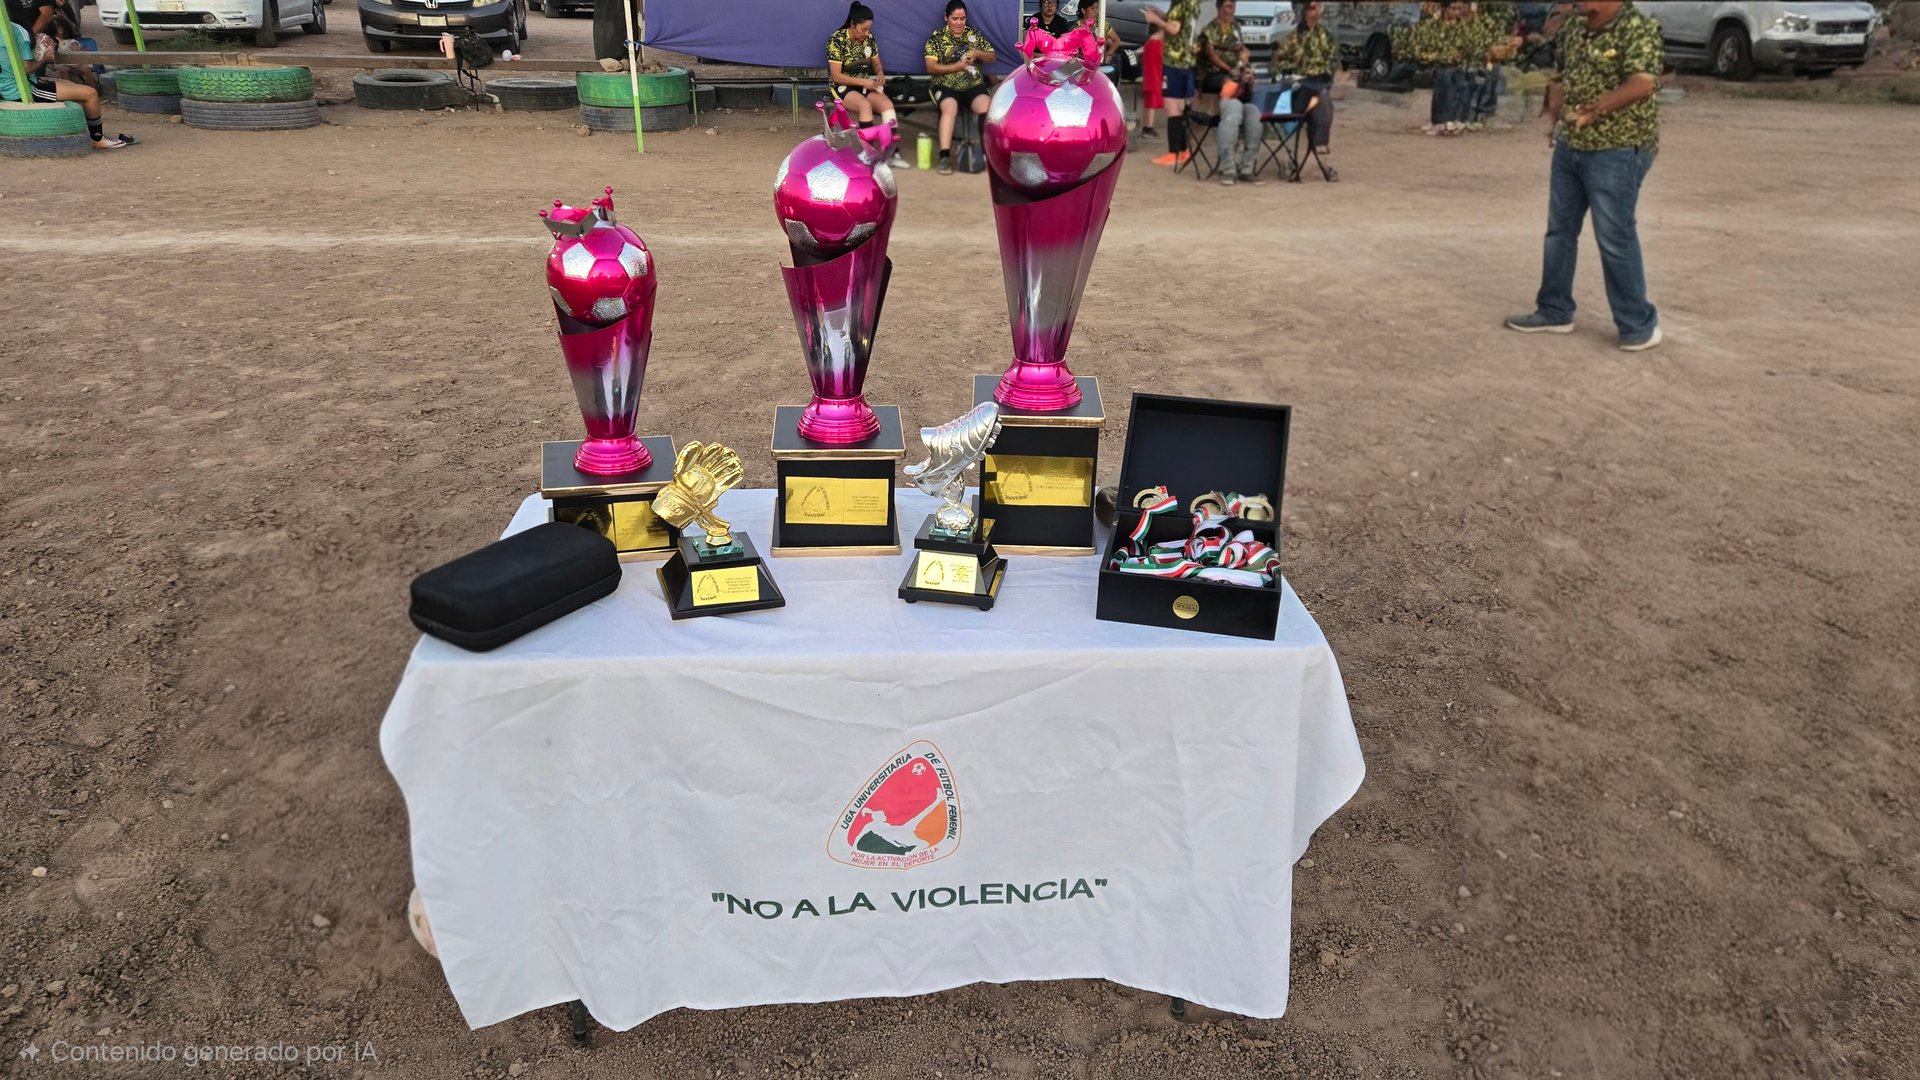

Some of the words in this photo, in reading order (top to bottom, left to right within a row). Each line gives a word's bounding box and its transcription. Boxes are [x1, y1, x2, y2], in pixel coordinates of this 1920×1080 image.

[841, 810, 857, 830] LIGA
[854, 753, 912, 808] UNIVERSITARIA
[924, 752, 941, 765] DE
[936, 768, 955, 801] FUTBOL
[947, 804, 957, 840] FEMENIL
[850, 851, 865, 860] POR
[919, 850, 929, 858] DE
[851, 857, 876, 866] MUJER
[903, 853, 936, 868] DEPORTE
[712, 892, 784, 920] "NO
[791, 898, 821, 919] A
[828, 892, 878, 916] LA
[890, 878, 1108, 913] VIOLENCIA"
